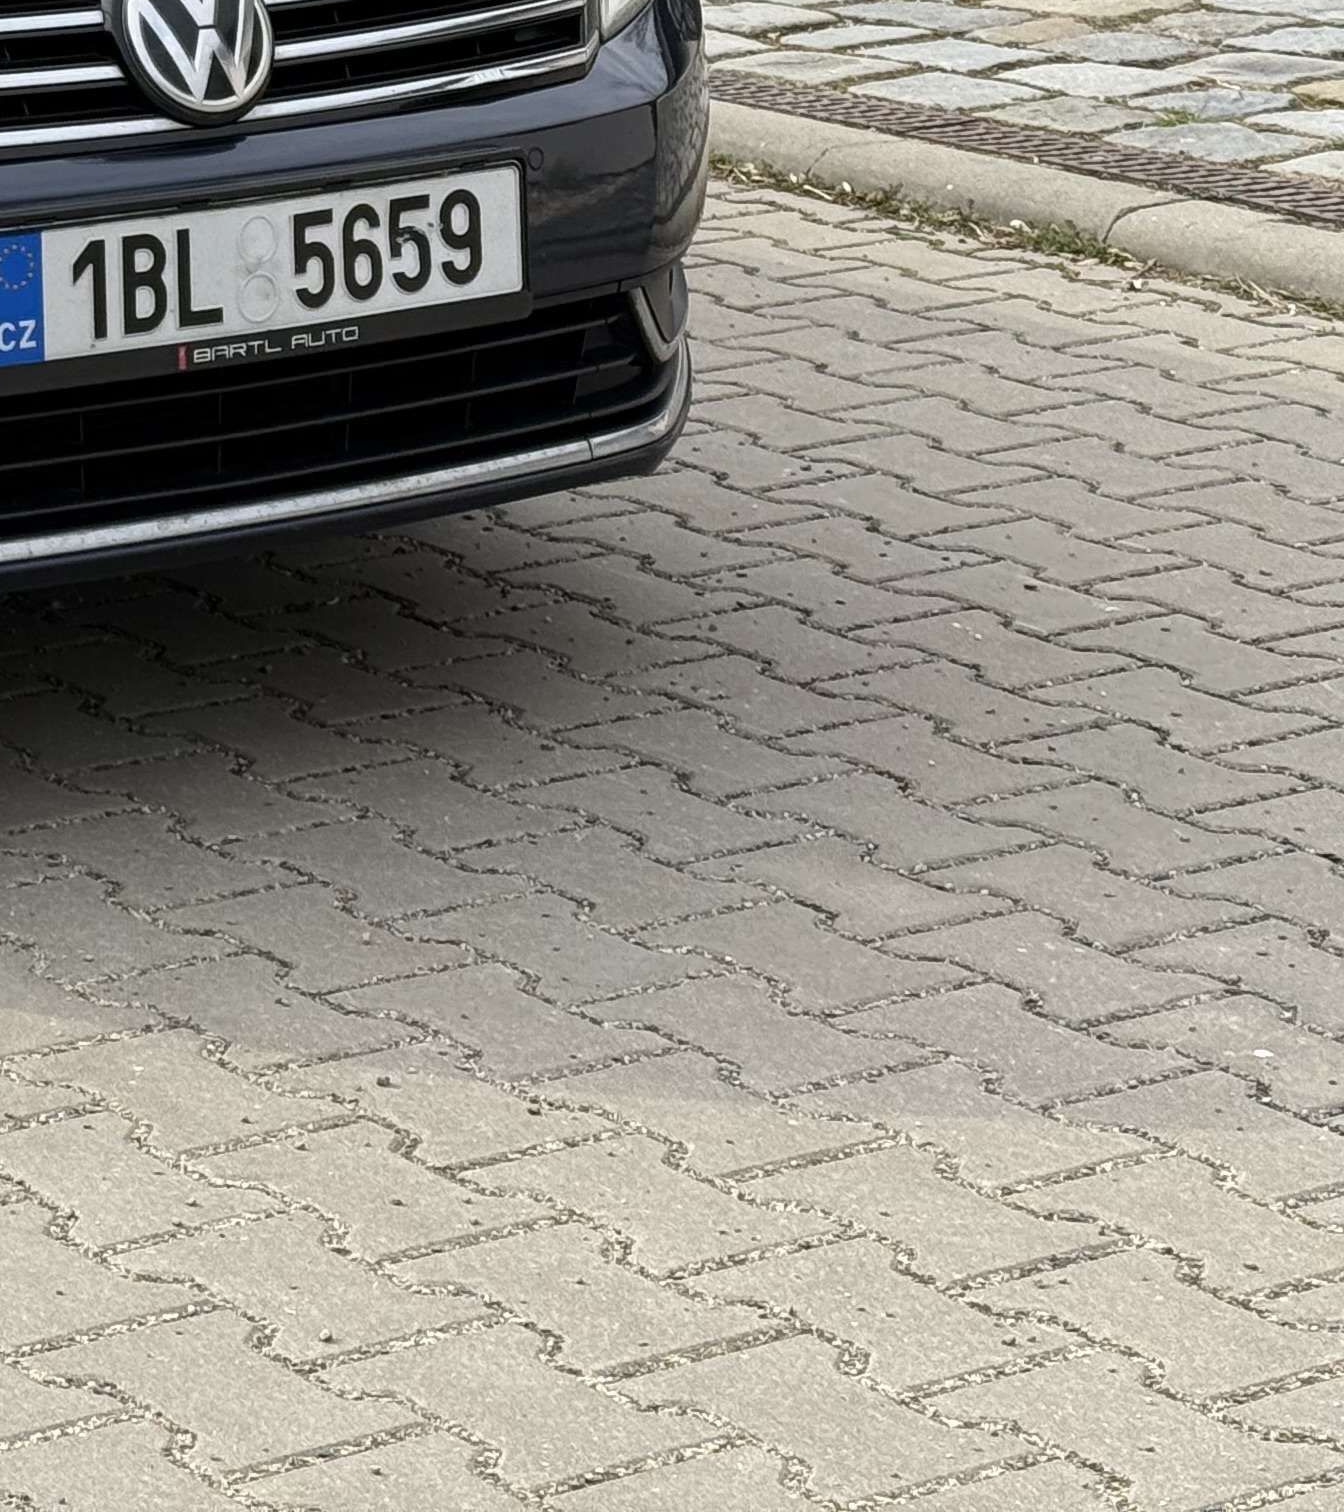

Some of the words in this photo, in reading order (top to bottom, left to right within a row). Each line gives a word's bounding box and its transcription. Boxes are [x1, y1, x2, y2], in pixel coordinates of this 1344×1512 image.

[72, 228, 224, 341] 1BL
[292, 189, 483, 309] 5659
[193, 339, 282, 364] BARTL
[291, 326, 360, 350] AUTO
